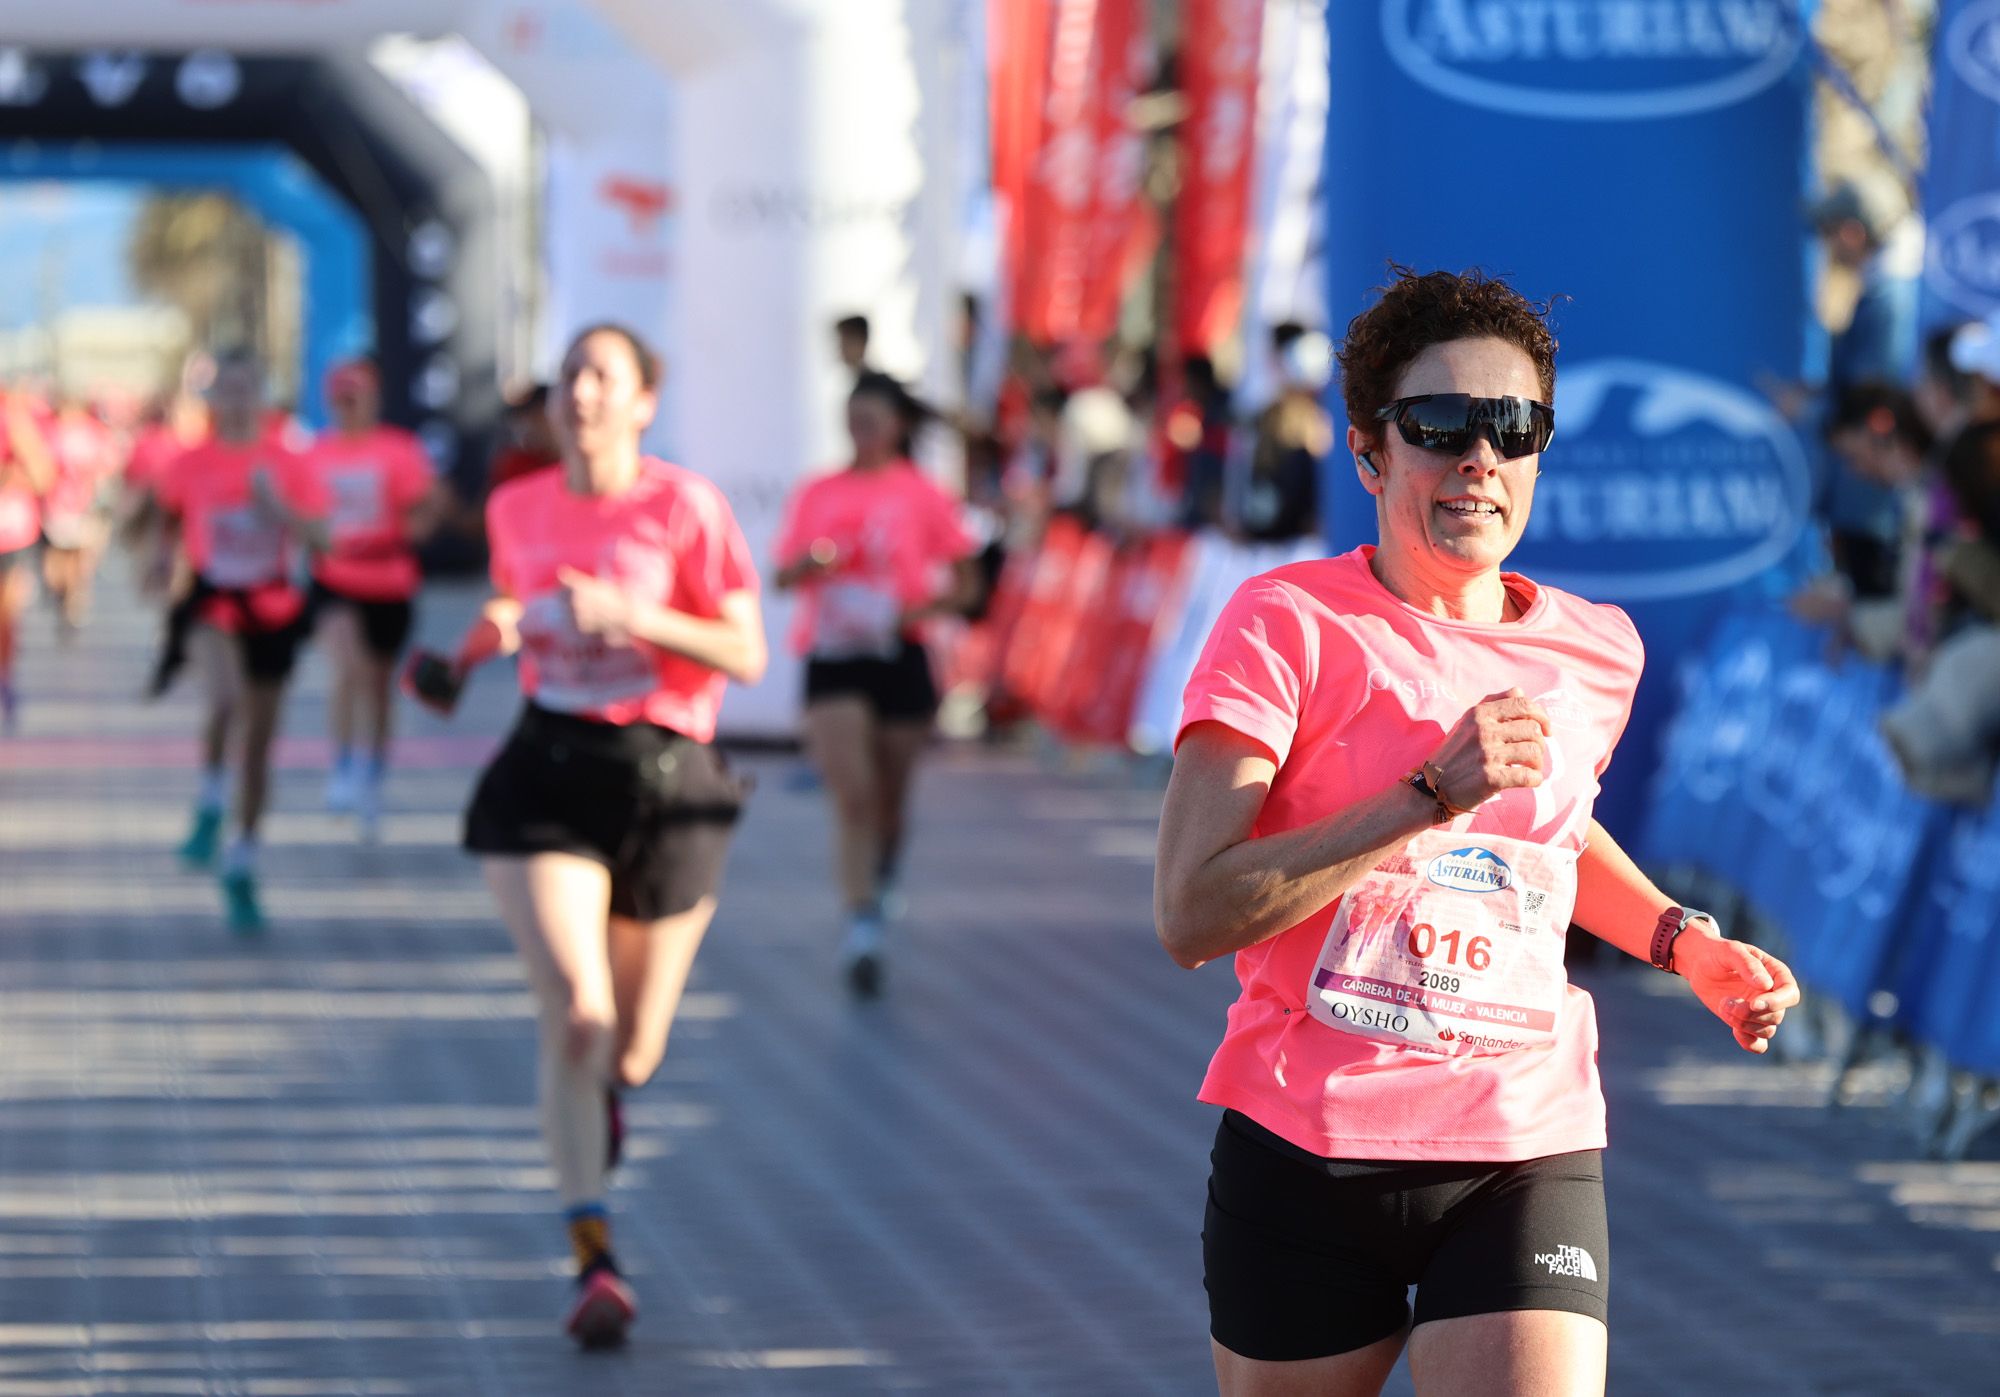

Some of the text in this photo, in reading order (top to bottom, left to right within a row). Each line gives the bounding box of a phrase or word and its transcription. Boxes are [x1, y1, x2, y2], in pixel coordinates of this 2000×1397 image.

[1403, 0, 1787, 60] ASTURIAN
[1367, 668, 1458, 702] OSHO
[1431, 859, 1506, 887] ASTURIANA
[1408, 923, 1492, 971] 016
[1418, 971, 1460, 993] 2089
[1342, 979, 1528, 1024] CARRERA DE LA MUJER VALENCIA
[1332, 1002, 1409, 1032] OYSHO
[1457, 1031, 1525, 1049] Santander
[1534, 1253, 1581, 1269] NORTH
[1557, 1244, 1580, 1258] THE
[1548, 1263, 1581, 1277] FACE
